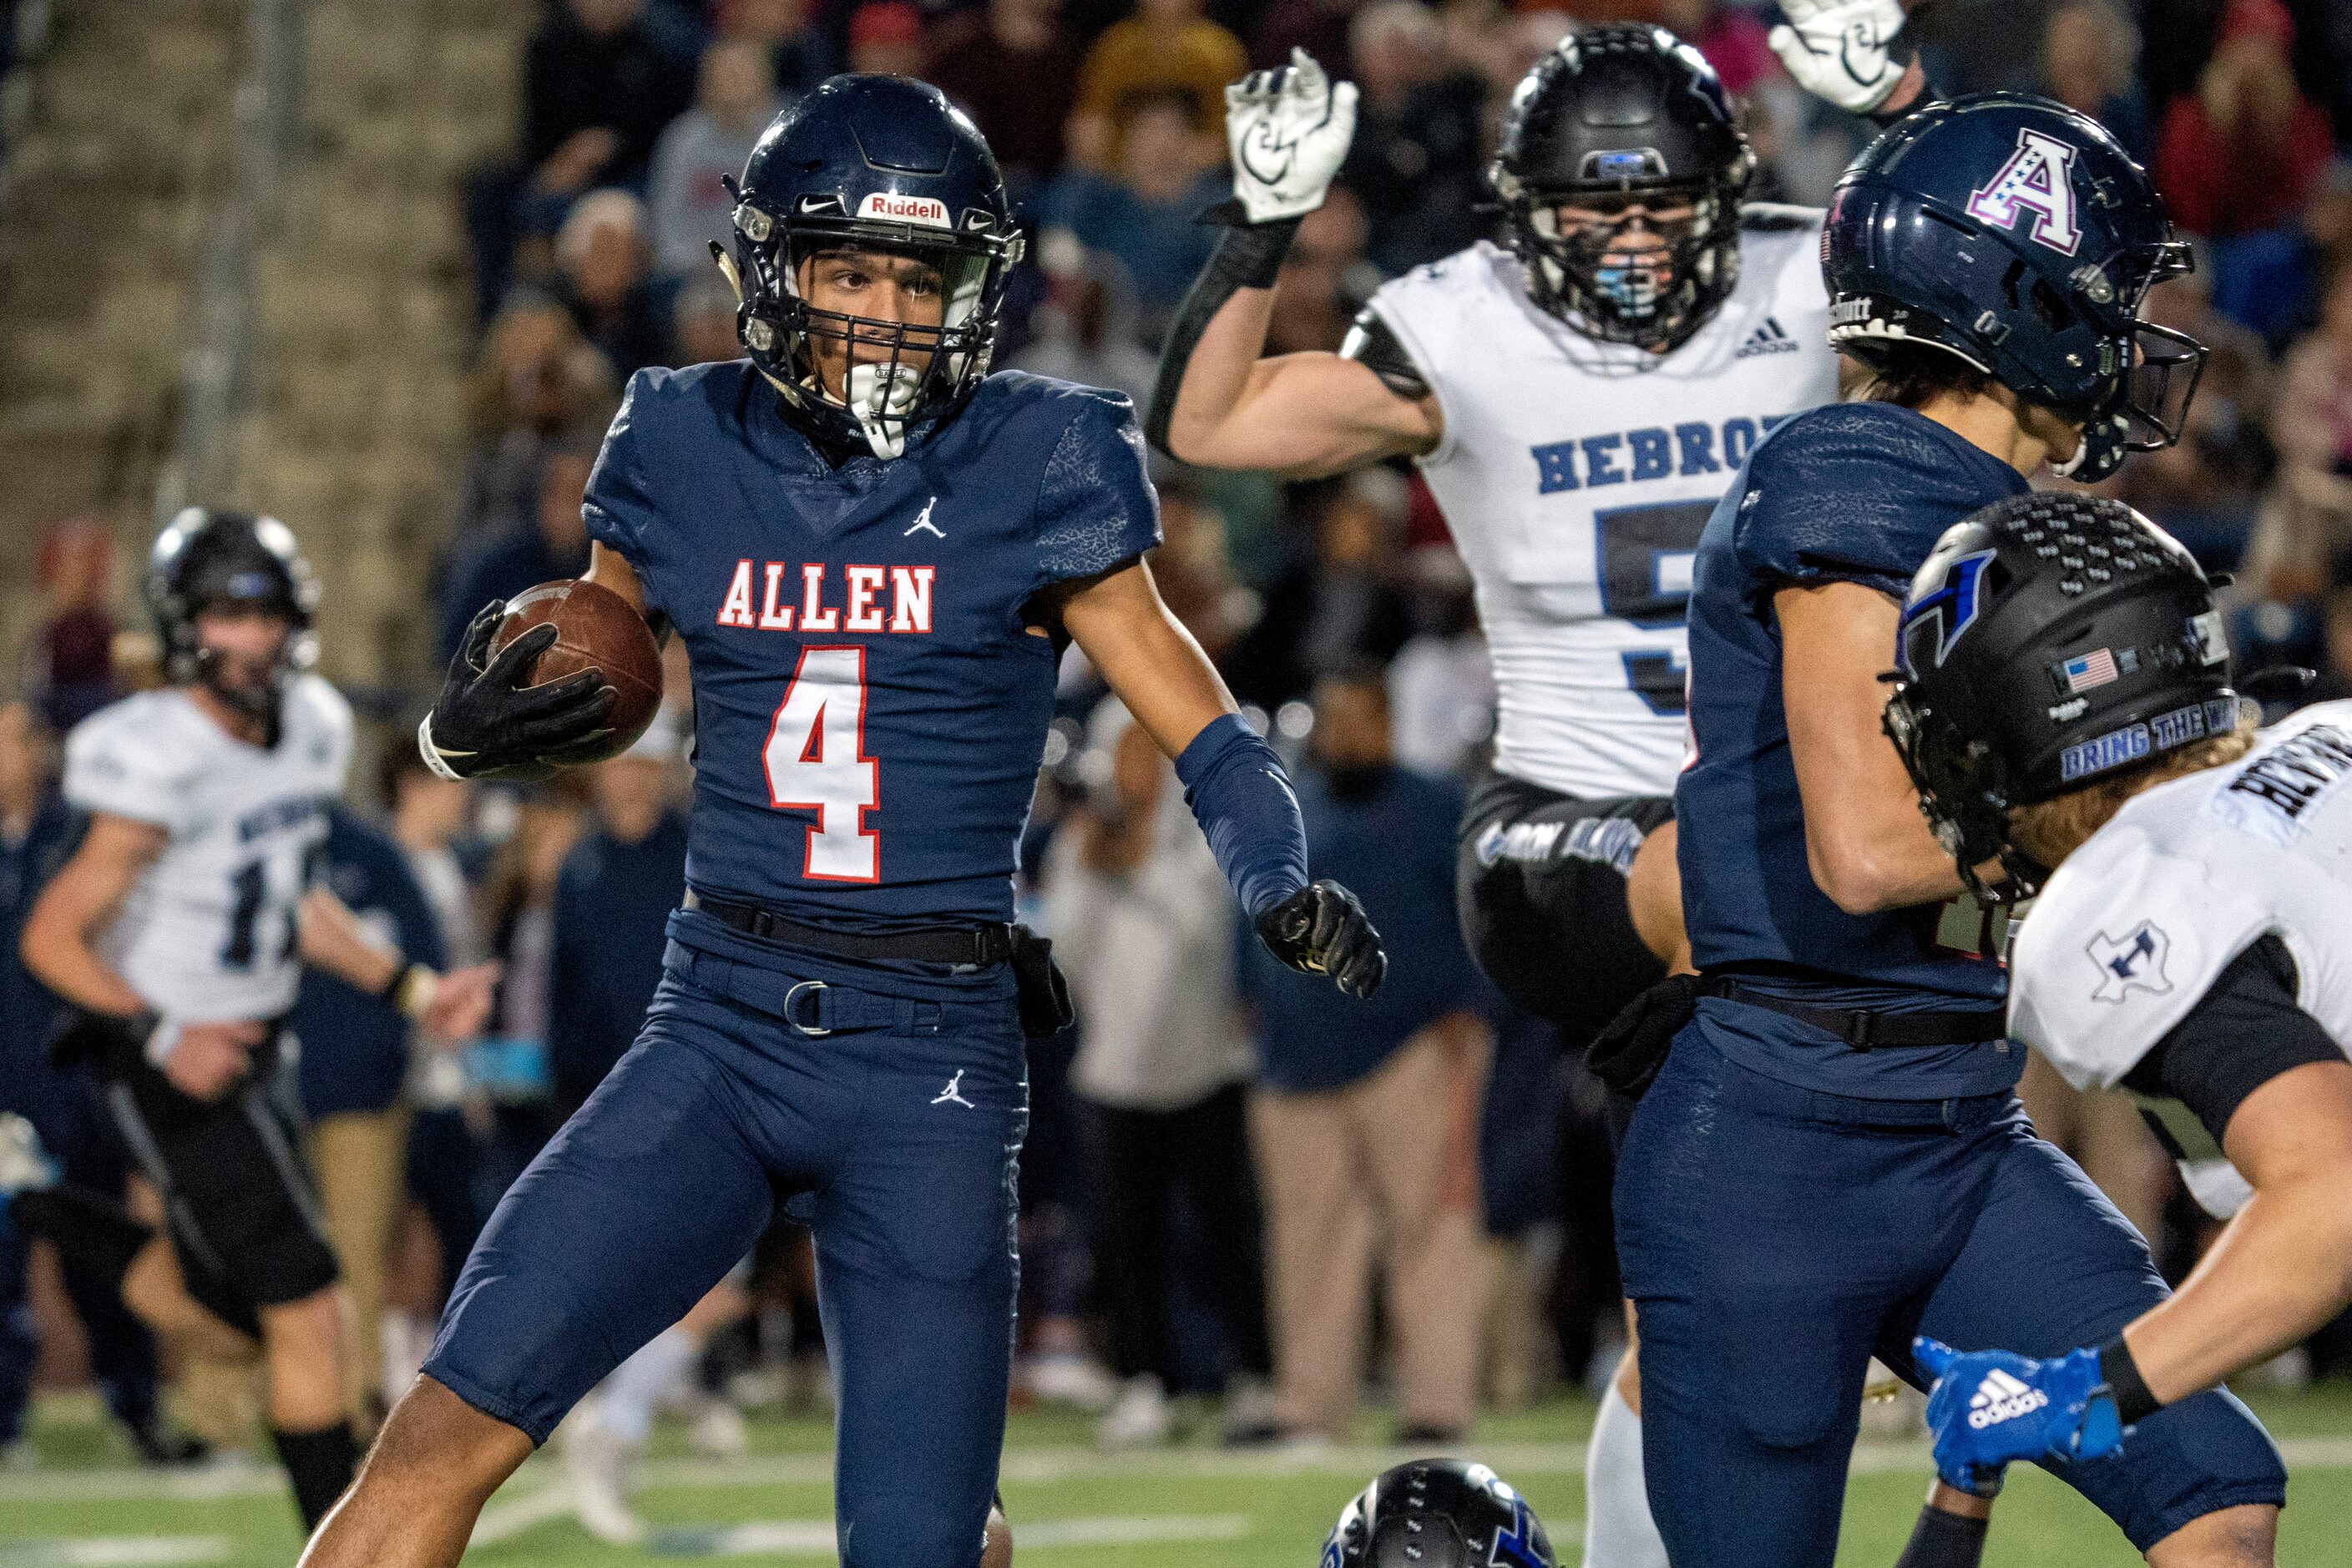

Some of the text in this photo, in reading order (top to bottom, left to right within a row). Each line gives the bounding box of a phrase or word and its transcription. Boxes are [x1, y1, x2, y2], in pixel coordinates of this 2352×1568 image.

[872, 197, 942, 219] Riddell
[1965, 128, 2083, 257] A
[716, 559, 935, 633] ALLEN
[761, 645, 880, 883] 4
[2060, 723, 2151, 782] BRING
[2150, 703, 2206, 750] THE
[1968, 1388, 2049, 1429] adidas
